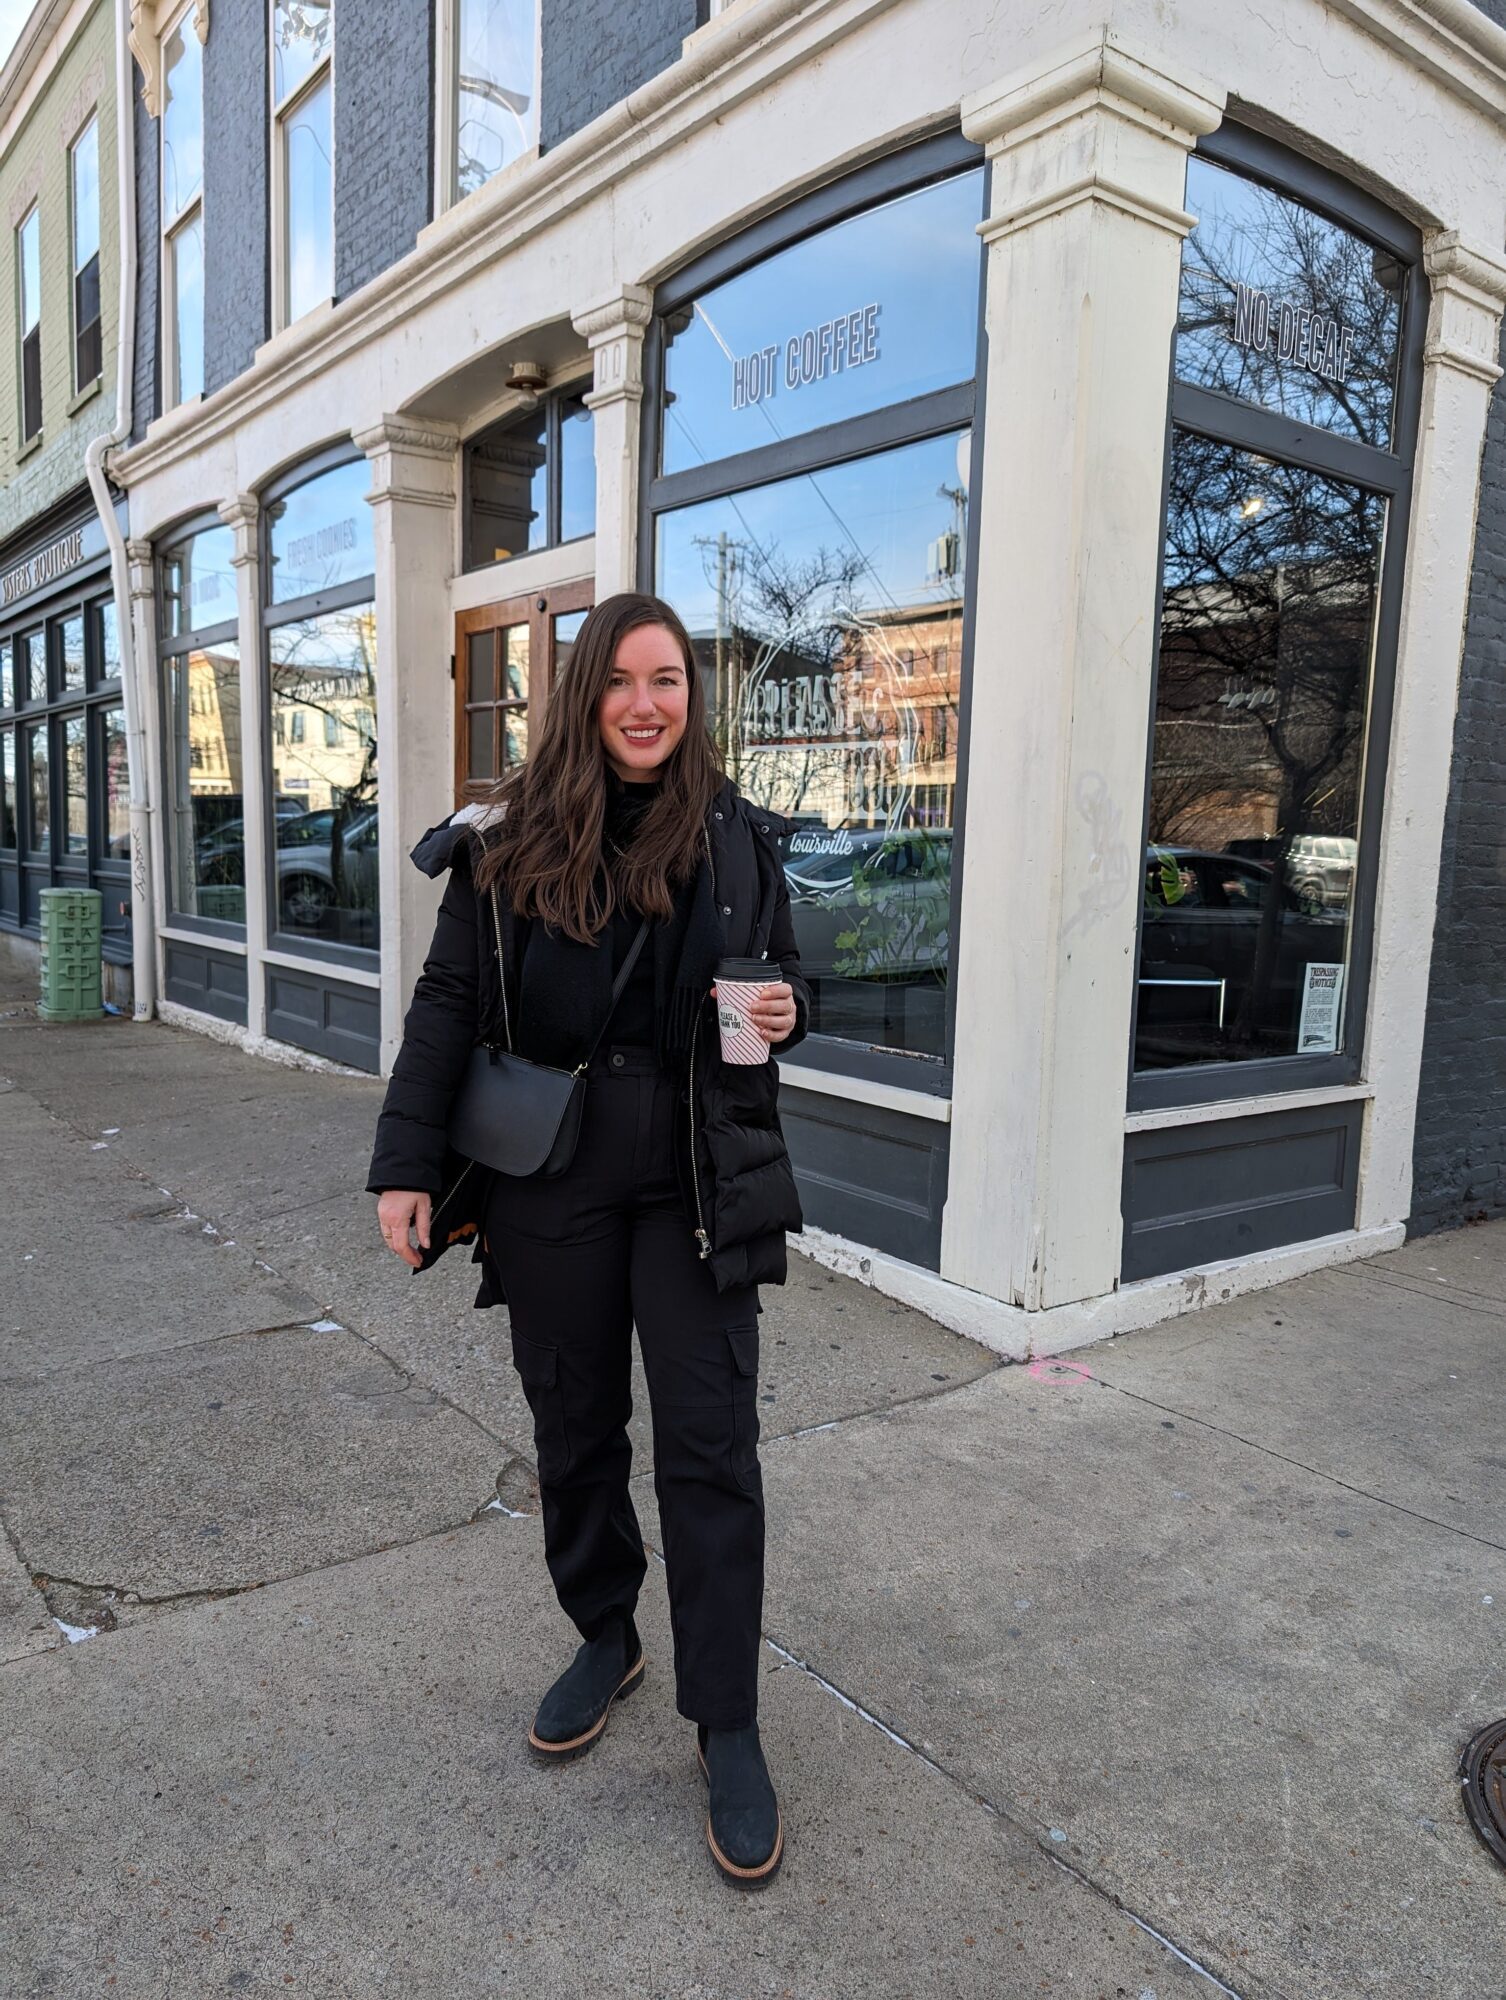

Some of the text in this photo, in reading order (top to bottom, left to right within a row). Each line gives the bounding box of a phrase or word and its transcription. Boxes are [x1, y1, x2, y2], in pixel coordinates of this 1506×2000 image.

[732, 302, 880, 411] HOT COFFEE
[1234, 281, 1354, 383] NO DECAF
[33, 529, 84, 586] BOUTIQUE
[287, 533, 317, 570] FRESH
[731, 1021, 741, 1029] YOU
